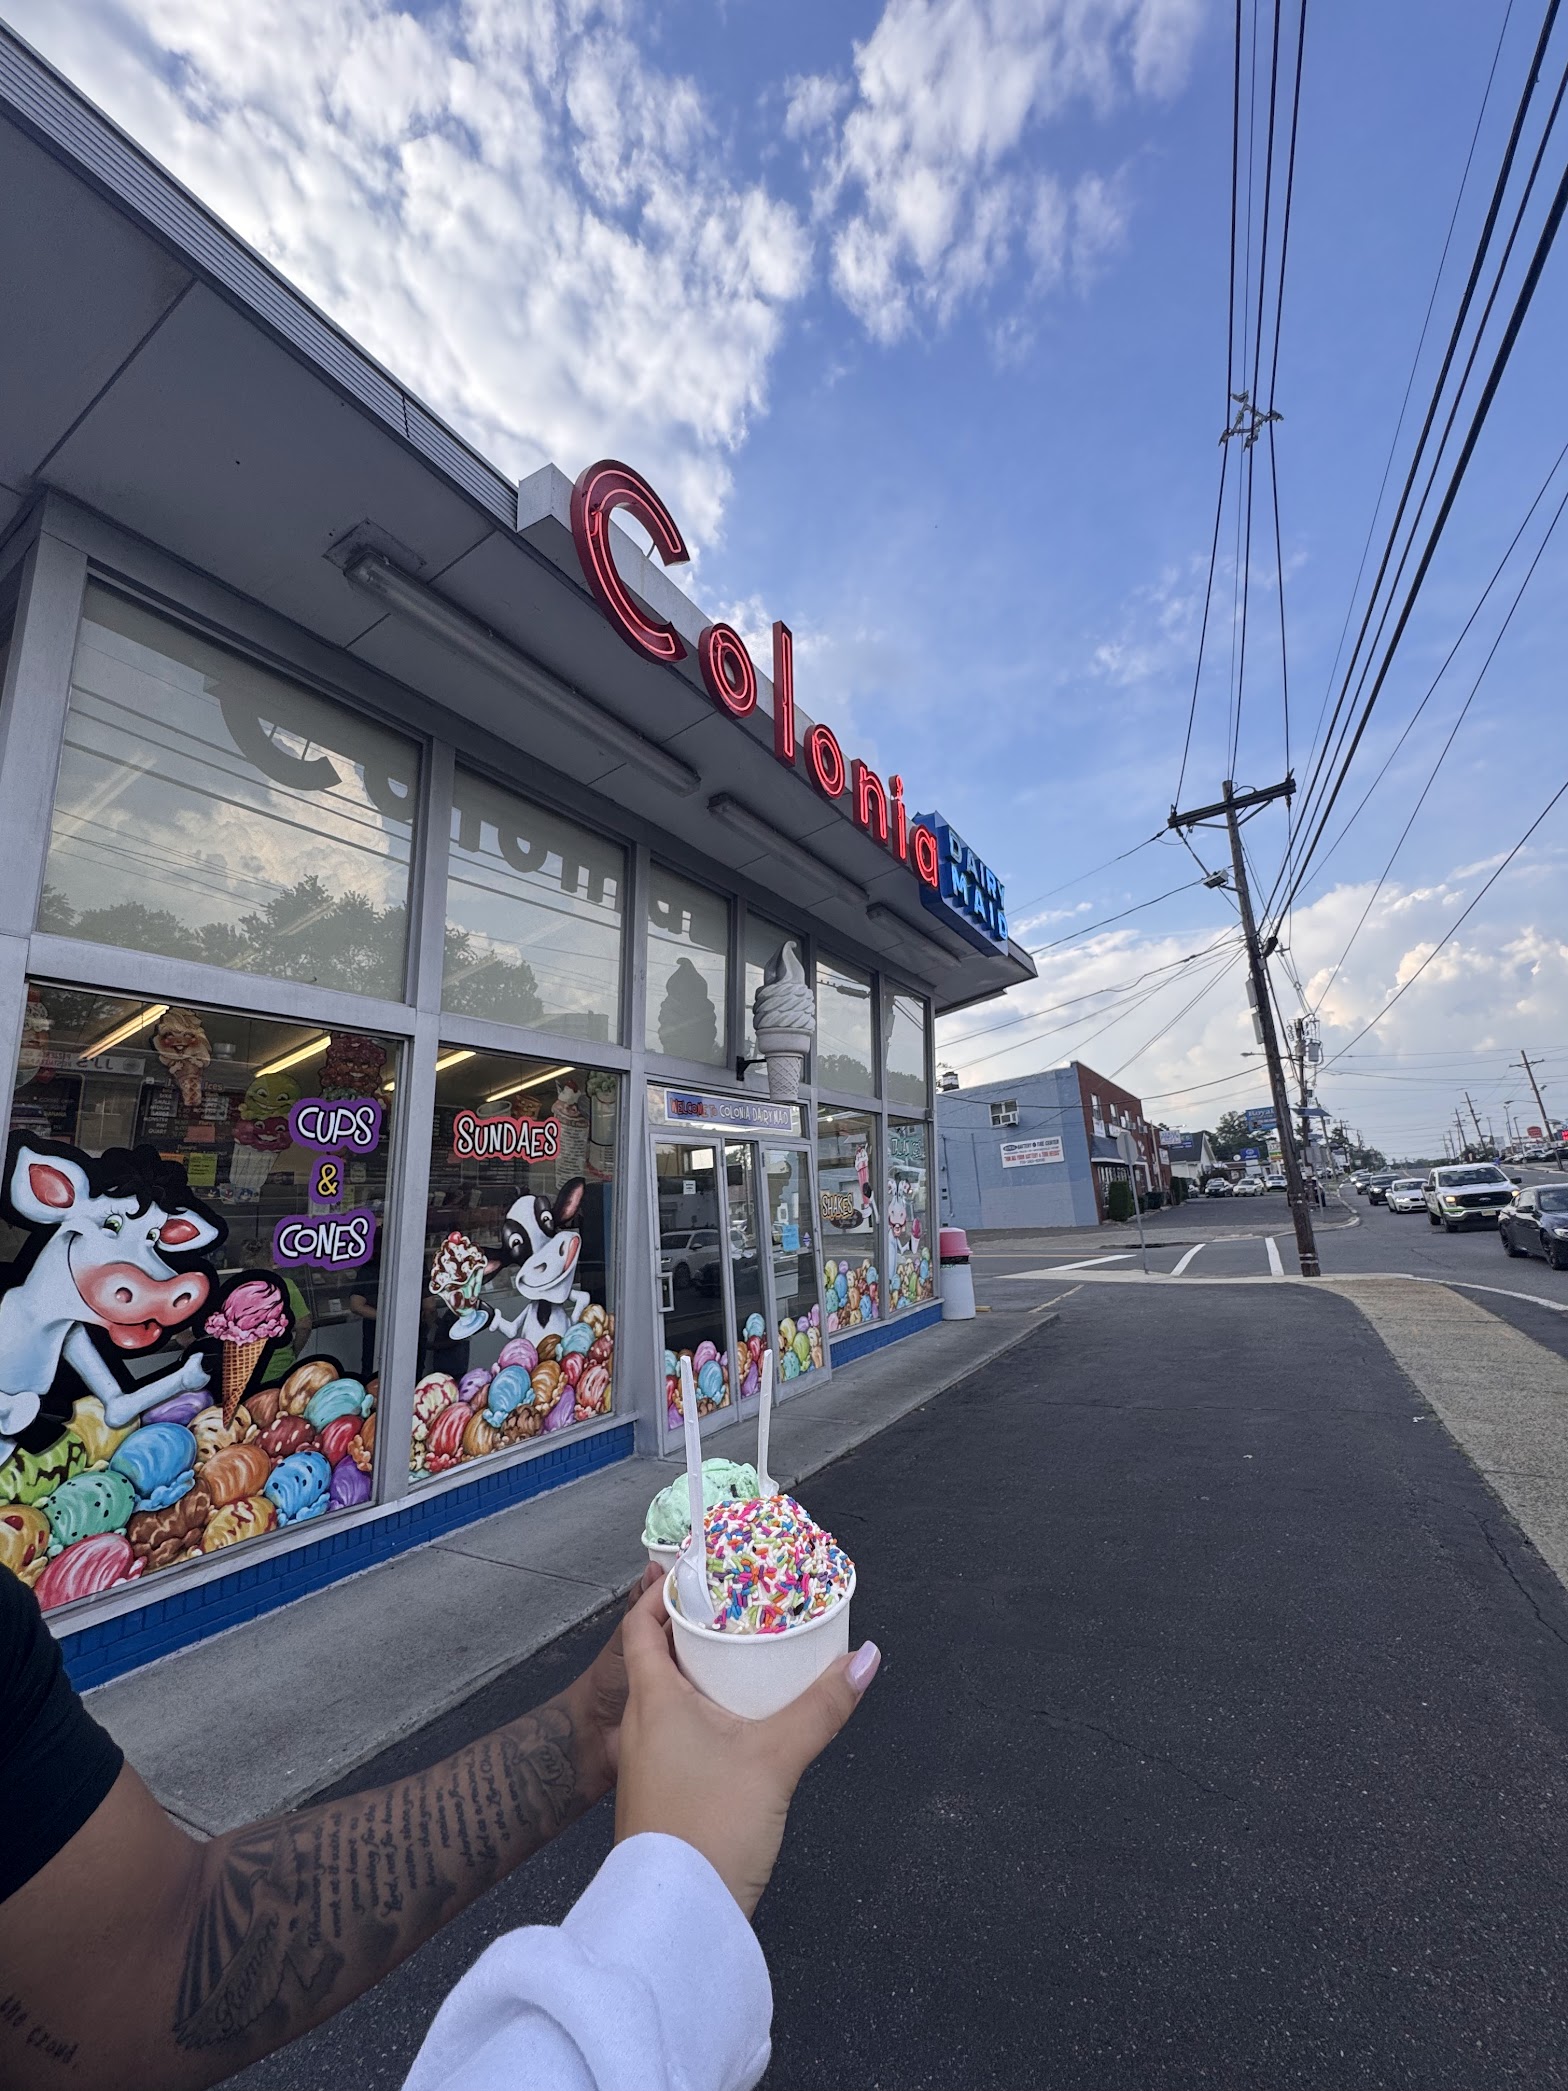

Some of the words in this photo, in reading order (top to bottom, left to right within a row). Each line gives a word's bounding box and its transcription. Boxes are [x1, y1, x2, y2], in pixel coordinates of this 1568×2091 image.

[570, 458, 939, 888] Colonia
[948, 830, 1005, 911] DAIRY
[950, 862, 1009, 942] MAID
[296, 1105, 376, 1147] CUPS
[669, 1098, 709, 1118] WELCOME
[719, 1104, 751, 1121] COLONIA
[752, 1107, 772, 1125] DAIRY
[773, 1110, 789, 1125] MAID
[1248, 1107, 1274, 1118] Royal
[456, 1115, 559, 1159] SUNDAES
[316, 1162, 338, 1198] &
[822, 1193, 853, 1218] SHAKES
[278, 1216, 370, 1264] CONES
